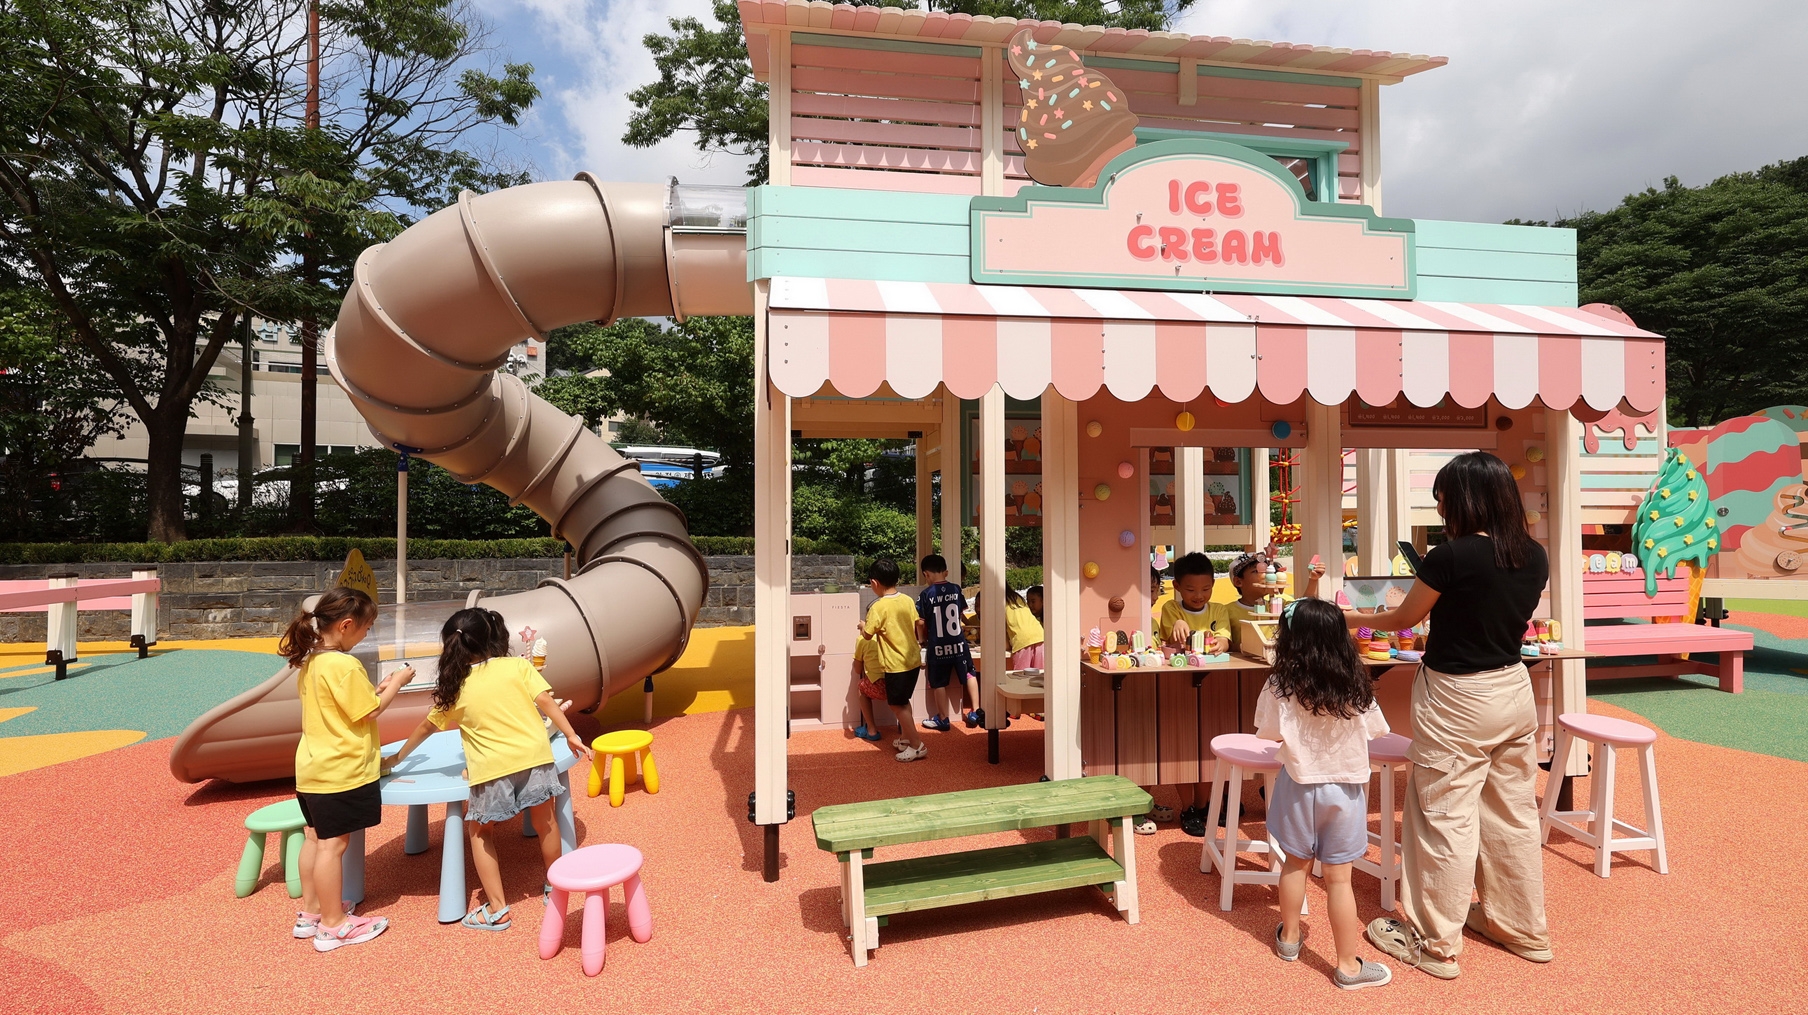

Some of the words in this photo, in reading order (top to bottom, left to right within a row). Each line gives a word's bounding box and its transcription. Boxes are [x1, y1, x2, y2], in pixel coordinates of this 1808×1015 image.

[1168, 179, 1245, 219] ICE
[1127, 224, 1286, 268] CREAM
[1582, 556, 1635, 570] ream
[937, 595, 943, 603] W
[932, 603, 962, 638] 18
[934, 641, 965, 657] GRIT
